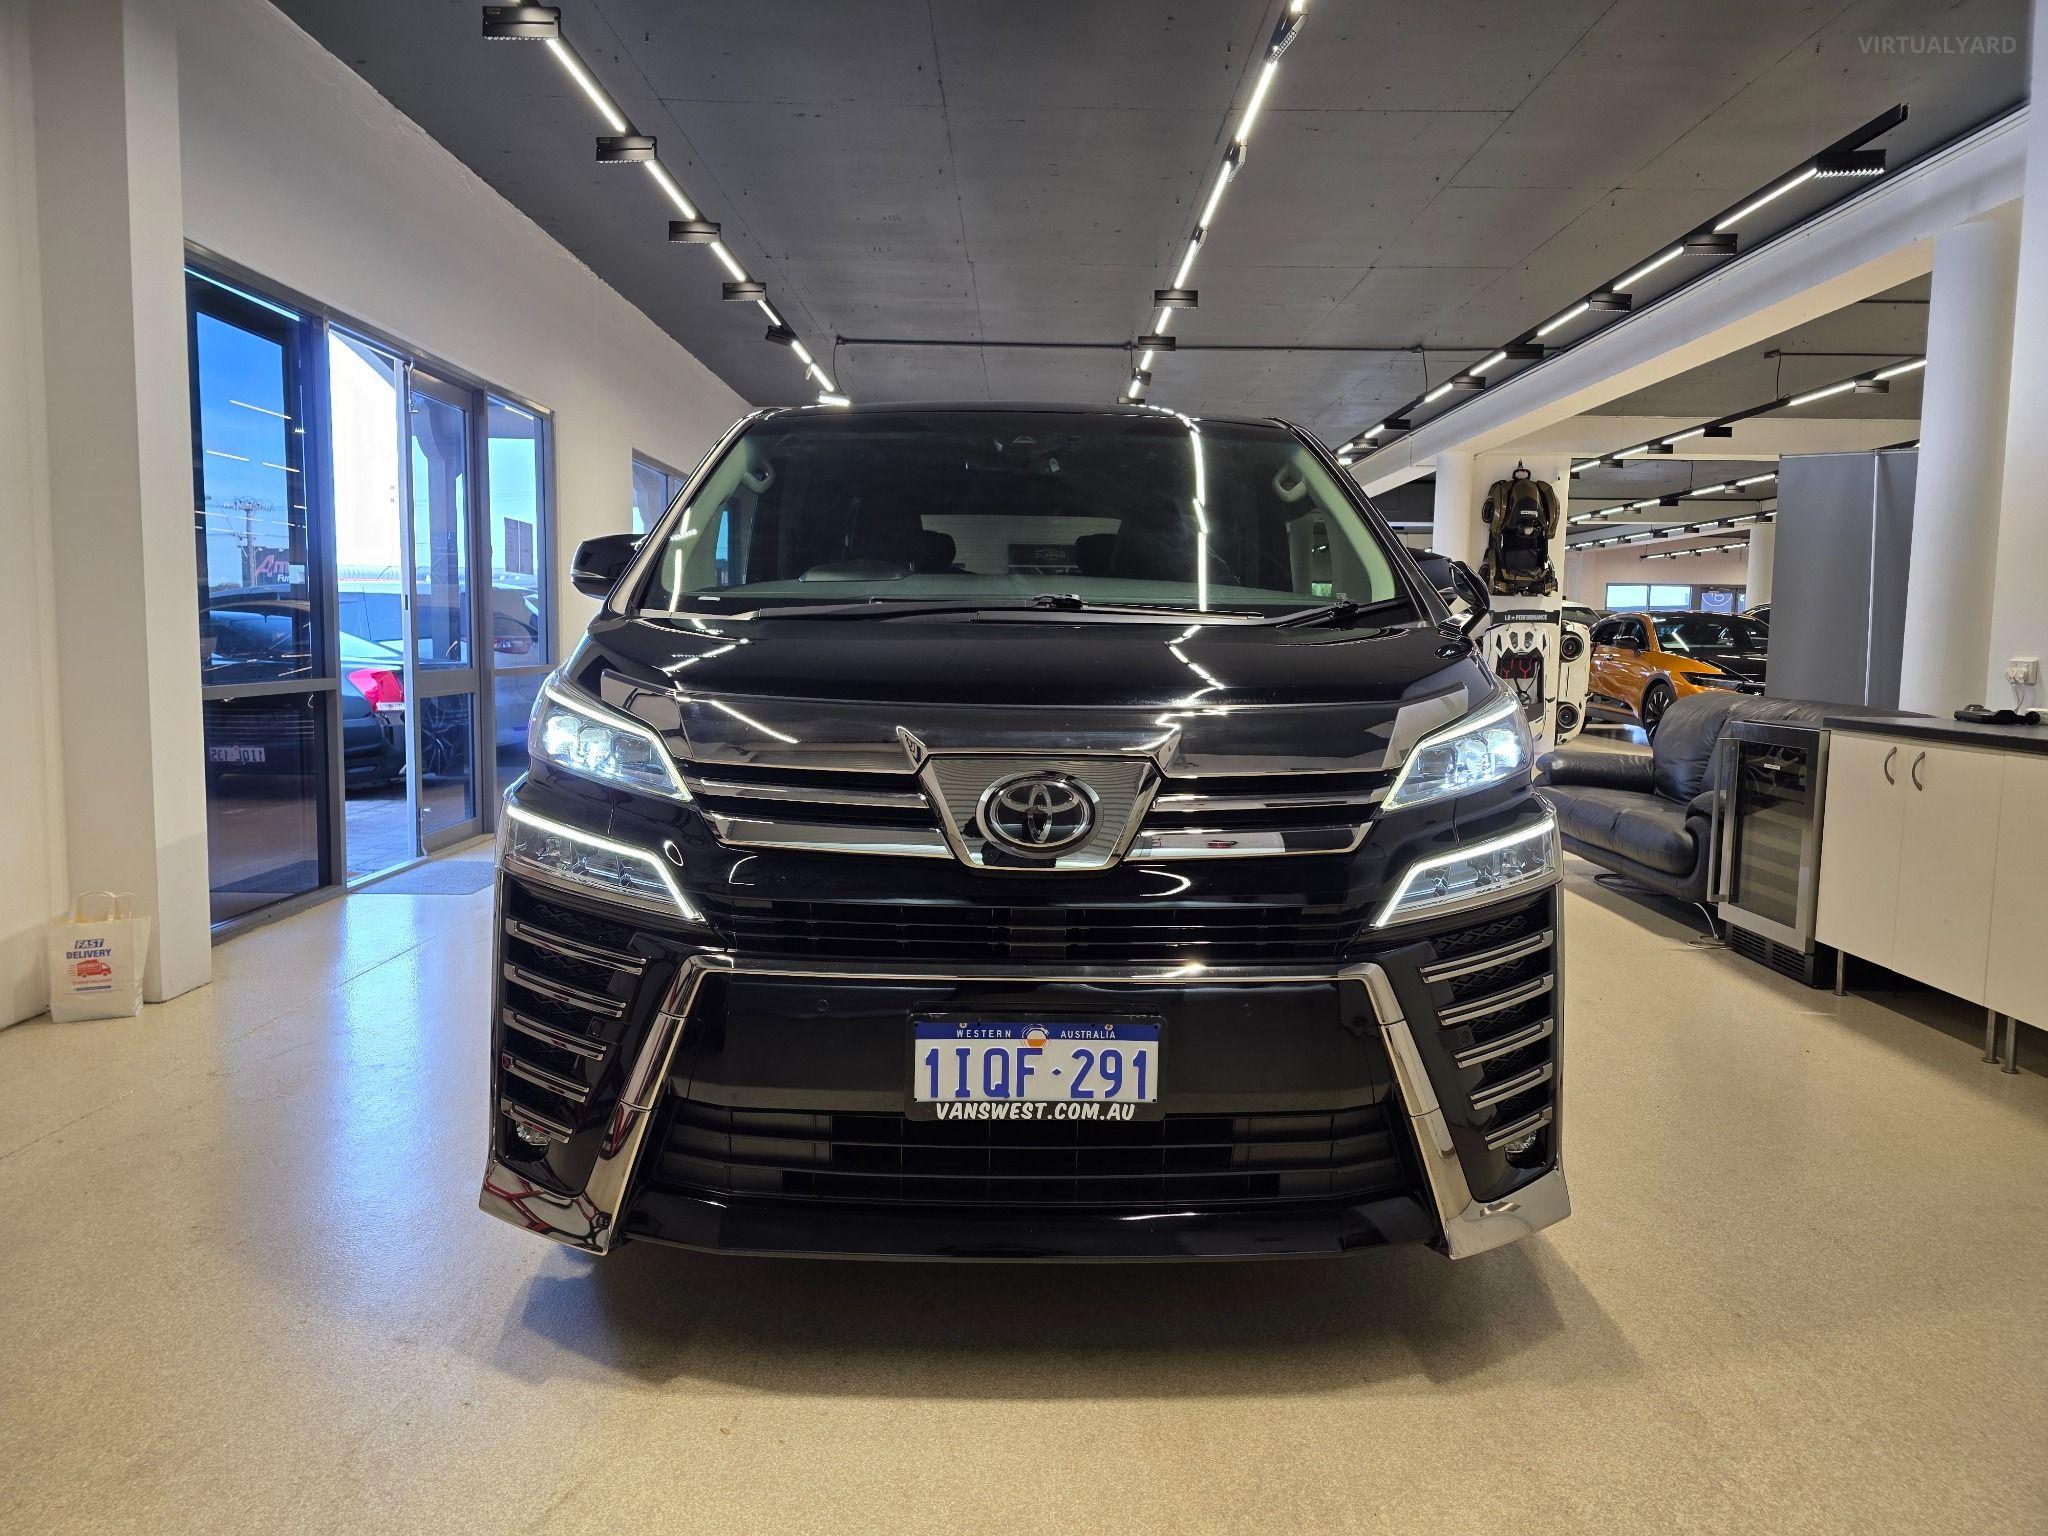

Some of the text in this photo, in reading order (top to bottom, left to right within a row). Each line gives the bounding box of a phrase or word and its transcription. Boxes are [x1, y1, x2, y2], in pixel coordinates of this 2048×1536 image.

[75, 938, 104, 949] FAST
[66, 949, 112, 959] DELIVERY
[956, 1029, 1116, 1040] WESTERN AUSTRALIA
[936, 1102, 1136, 1121] VANSWEST.COM.AU
